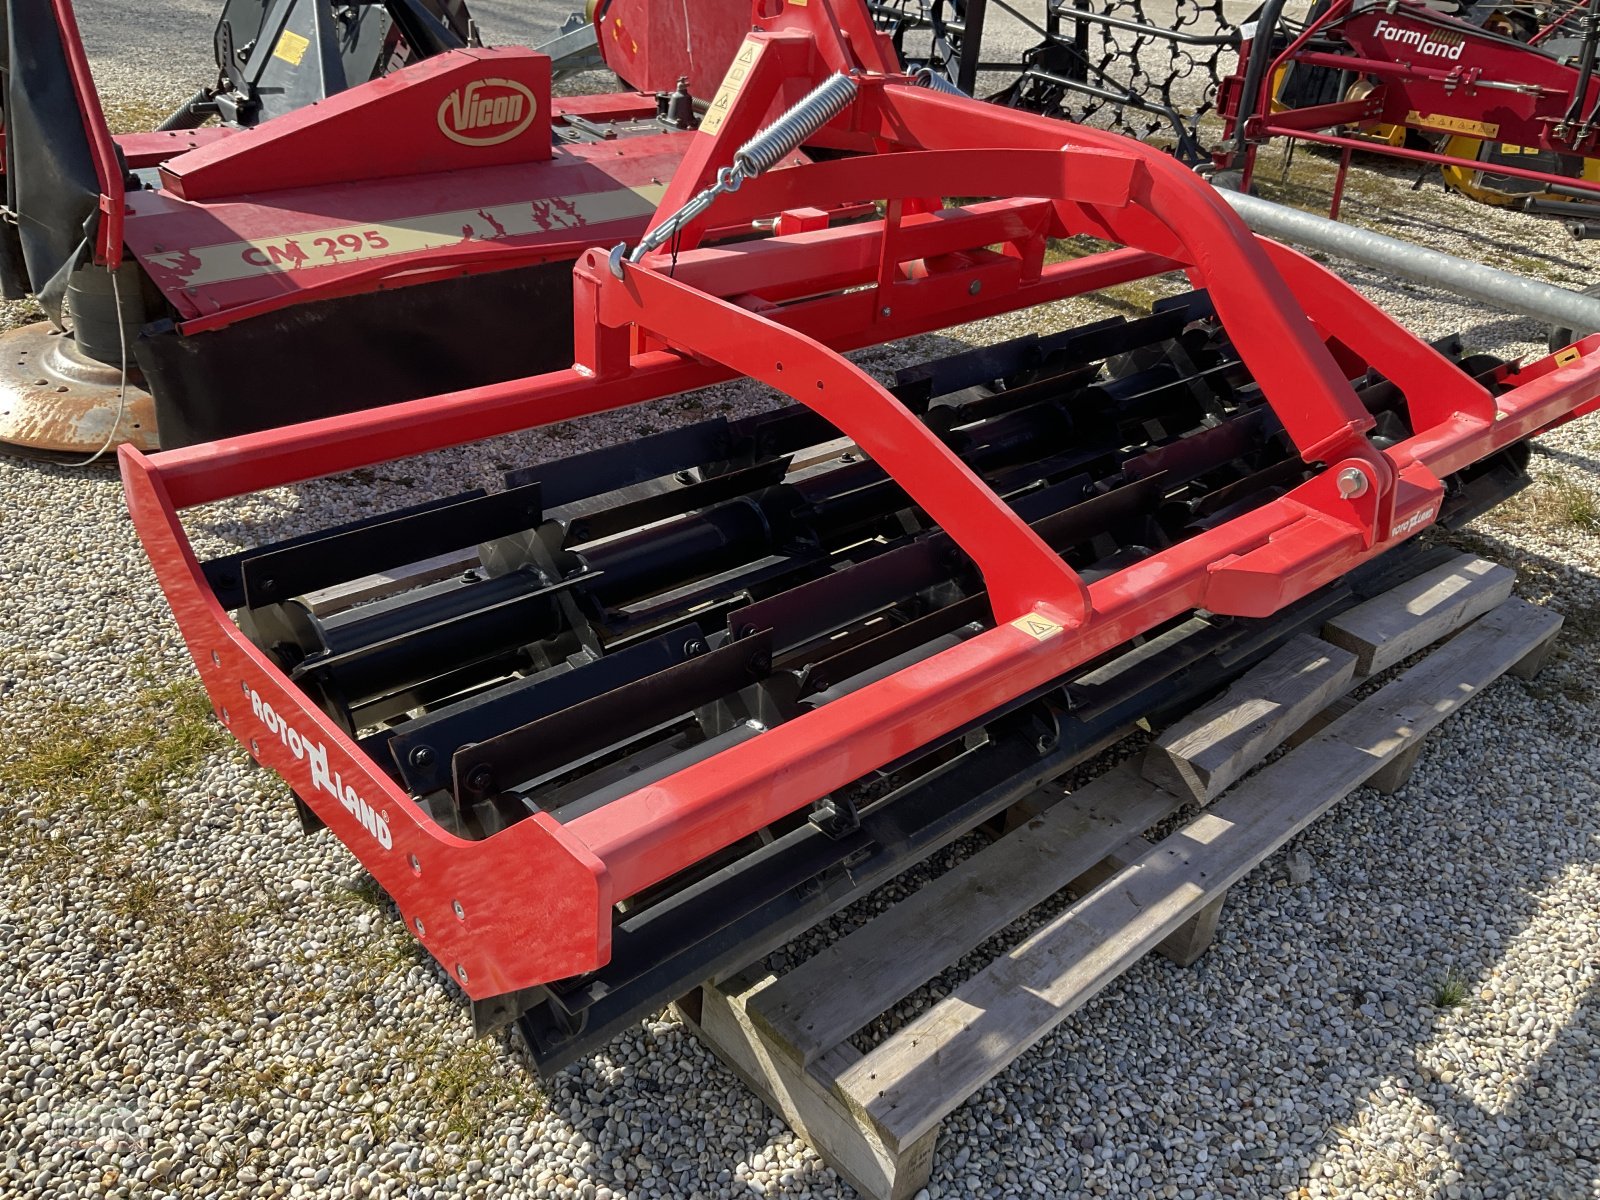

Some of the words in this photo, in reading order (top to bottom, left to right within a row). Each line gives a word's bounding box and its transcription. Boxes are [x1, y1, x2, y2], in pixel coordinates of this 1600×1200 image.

[1373, 20, 1466, 60] Farmland
[451, 86, 524, 131] Vicon
[242, 240, 310, 268] CM
[313, 230, 389, 258] 295
